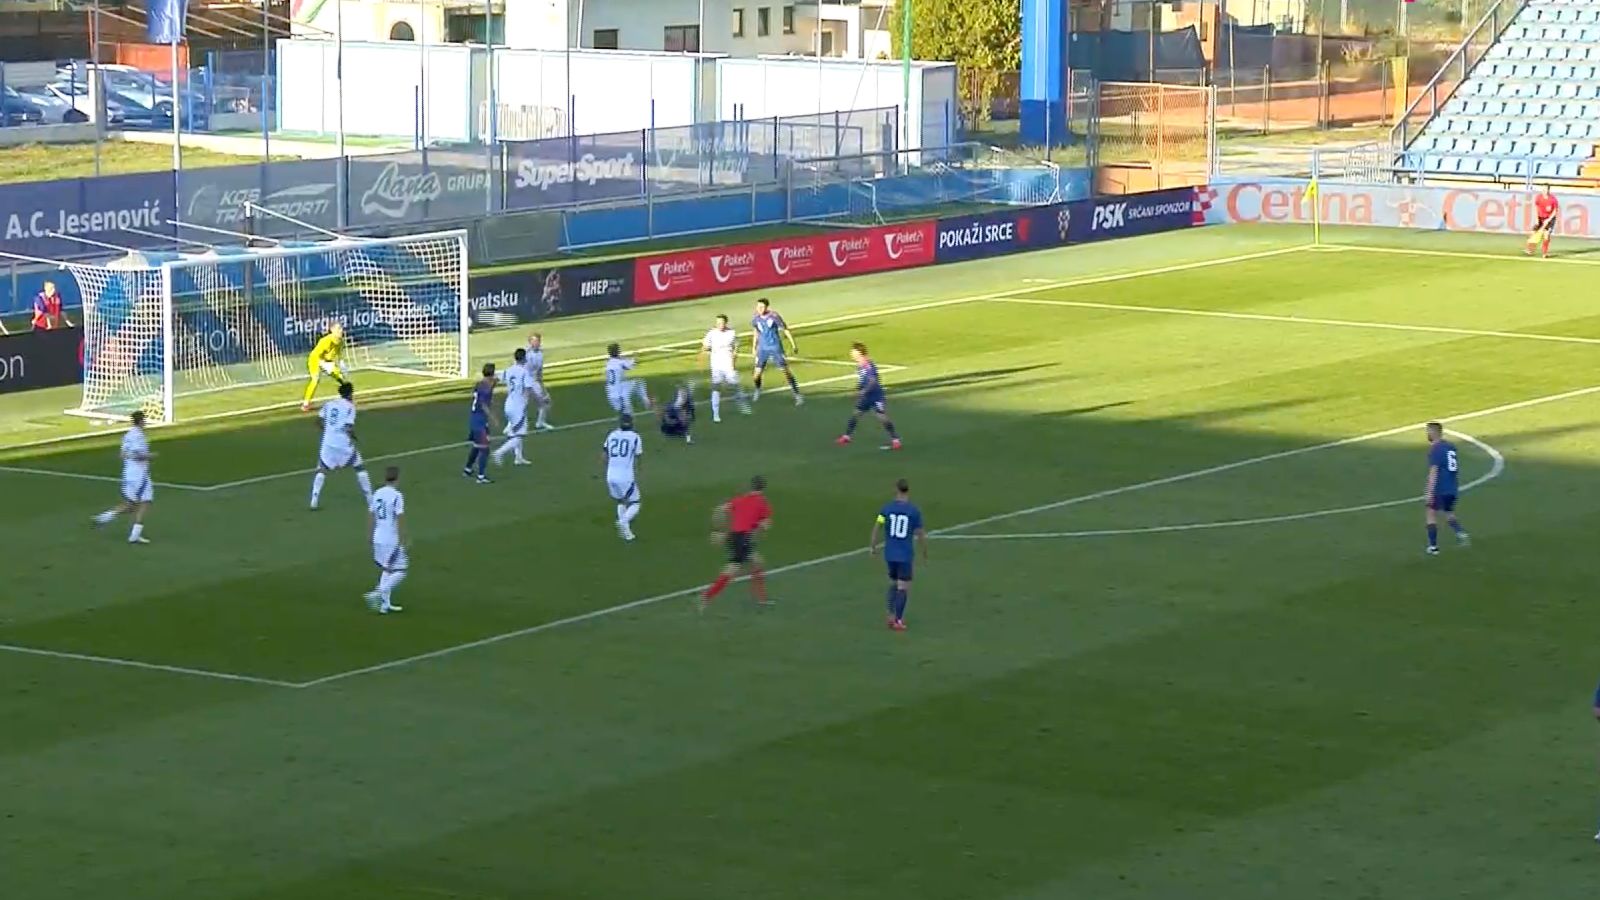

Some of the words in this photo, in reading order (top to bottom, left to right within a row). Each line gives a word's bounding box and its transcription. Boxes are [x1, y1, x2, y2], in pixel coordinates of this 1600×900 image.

[448, 173, 491, 191] GRUPA
[515, 153, 634, 191] SuperSport
[1092, 202, 1127, 230] PSK
[1226, 183, 1372, 224] Cetna
[1442, 190, 1589, 234] Cetia
[5, 211, 50, 240] A.C.
[57, 200, 160, 235] Jesenović
[940, 222, 982, 248] POKAŽI
[985, 222, 1013, 242] SRCE
[610, 438, 629, 457] 20
[1446, 450, 1458, 471] 6
[889, 513, 909, 538] 10
